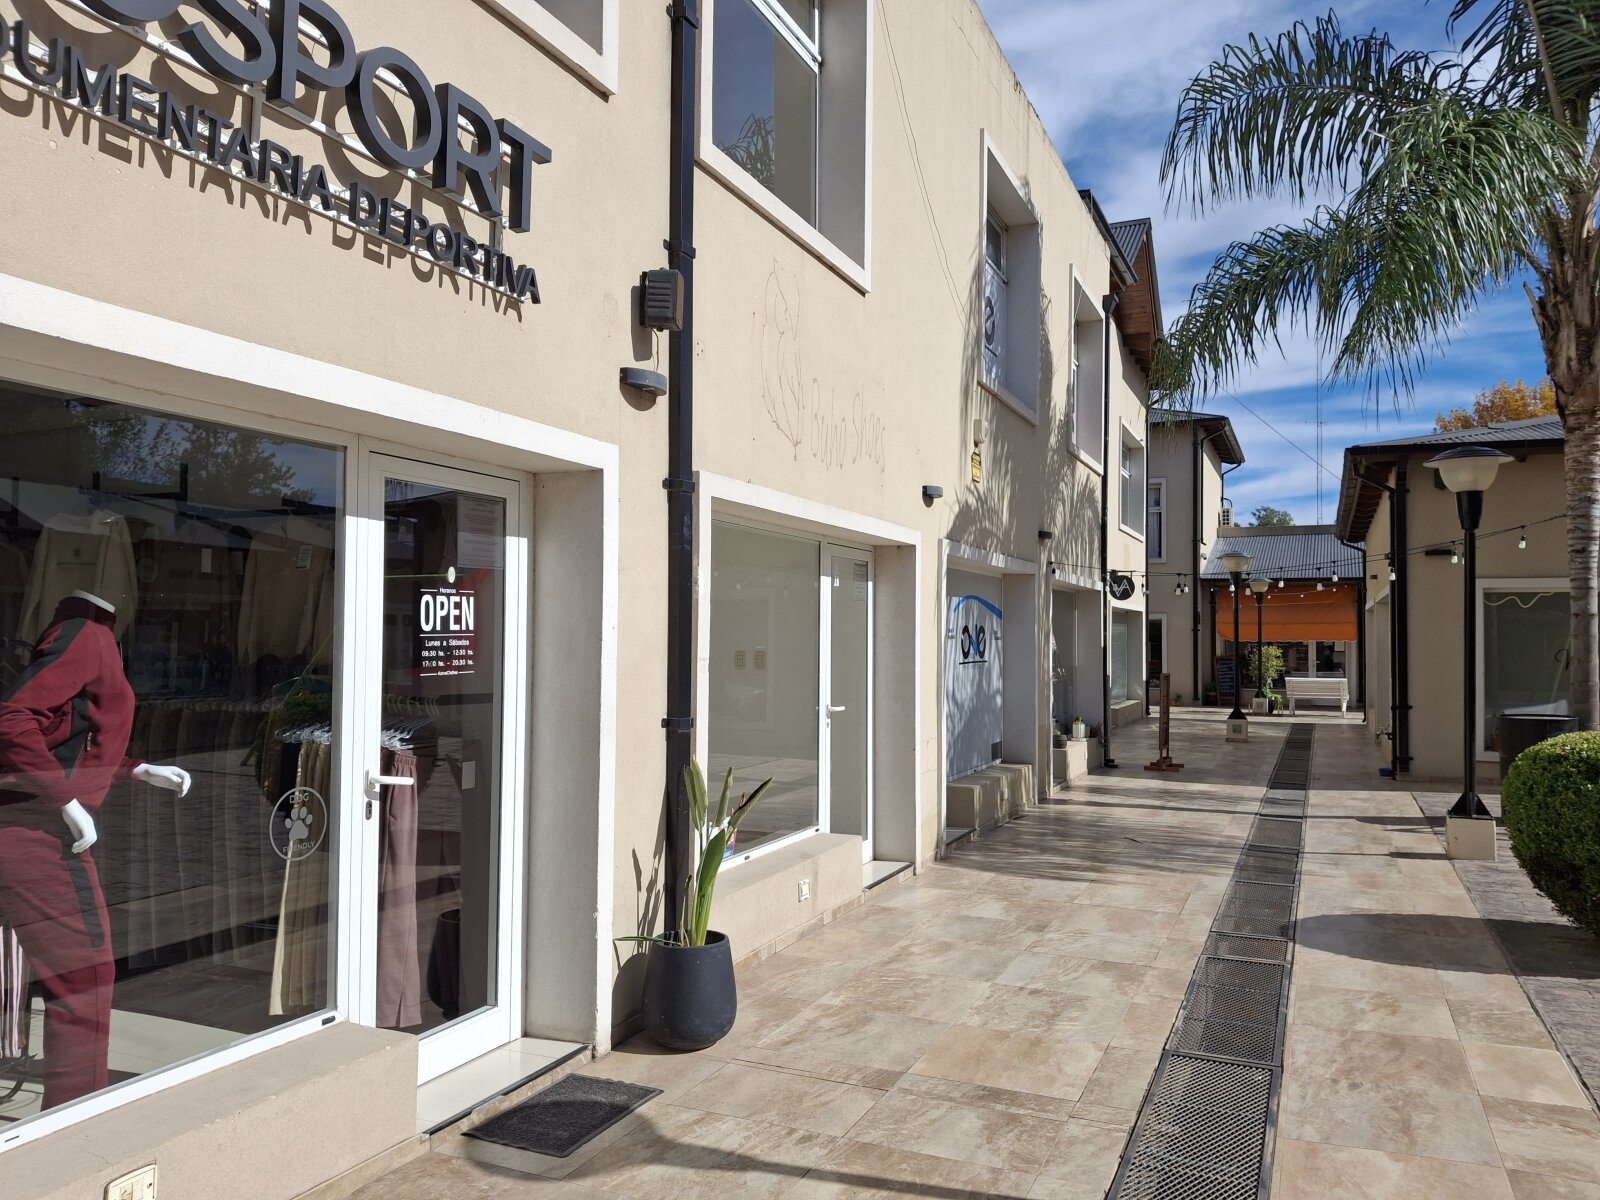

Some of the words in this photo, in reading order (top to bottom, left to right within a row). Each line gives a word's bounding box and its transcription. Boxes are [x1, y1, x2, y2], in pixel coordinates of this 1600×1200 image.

[80, 0, 552, 233] SPORT
[0, 15, 334, 211] UMENTARIA
[348, 182, 542, 304] DEPORTIVA
[420, 594, 475, 632] OPEN
[289, 793, 310, 804] DOG
[282, 841, 316, 854] FENDLY
